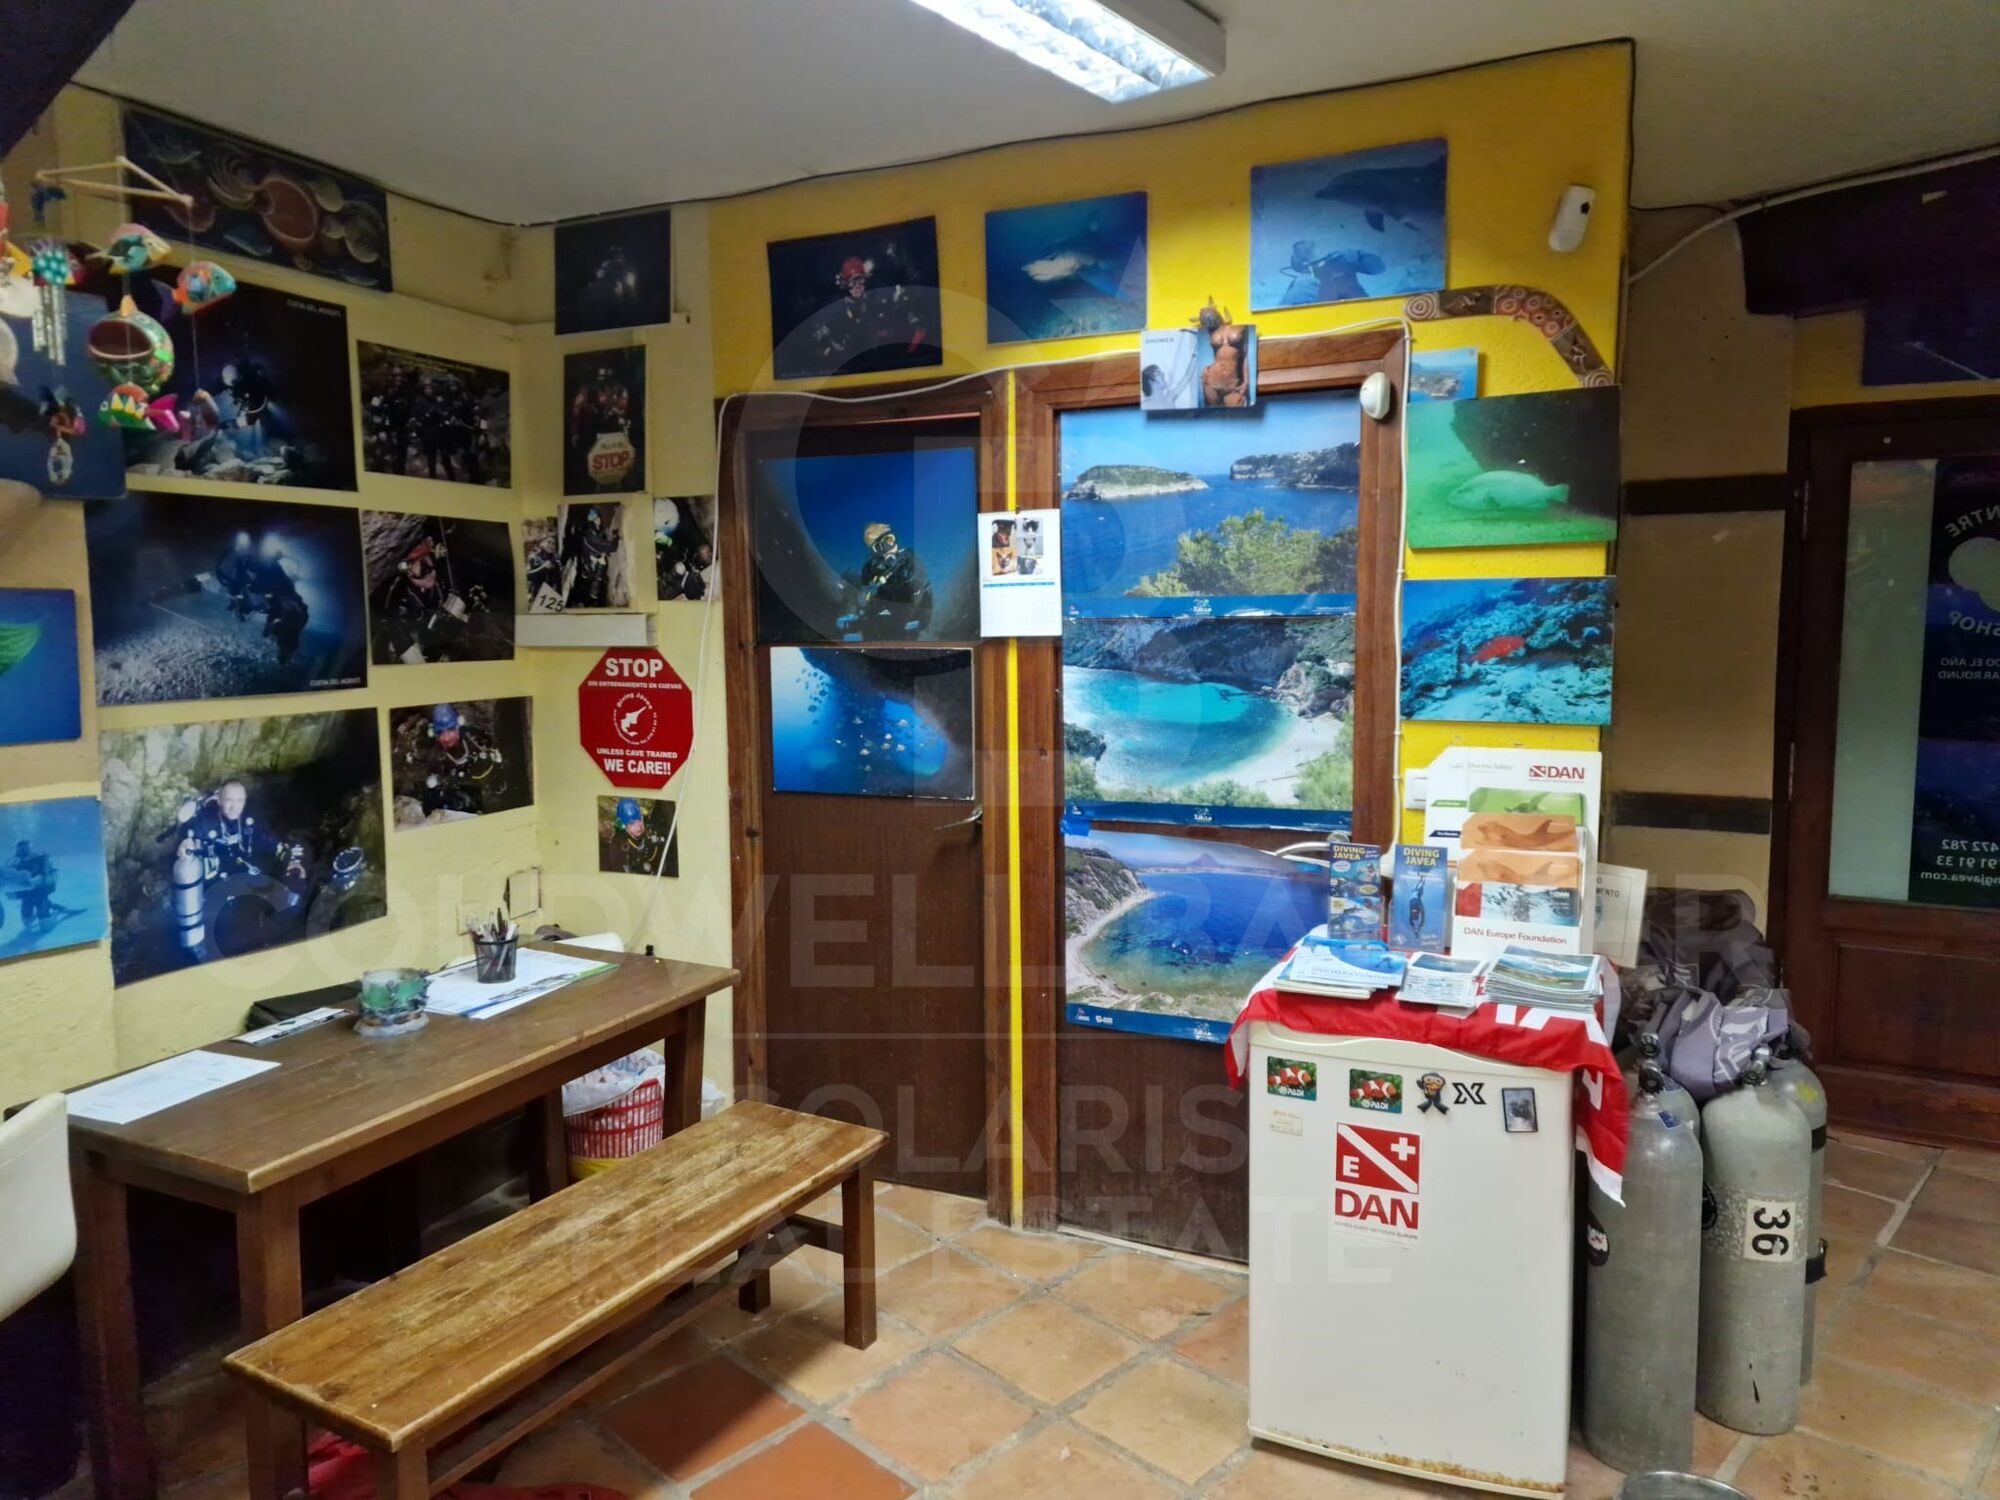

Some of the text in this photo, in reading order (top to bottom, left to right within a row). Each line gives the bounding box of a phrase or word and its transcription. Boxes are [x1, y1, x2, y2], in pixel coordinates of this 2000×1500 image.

[592, 451, 630, 470] STOP
[539, 594, 565, 613] 125
[605, 657, 664, 678] STOP
[596, 747, 678, 759] UNLESS CAVE TRAINED
[603, 758, 672, 776] WE CARE!!
[1547, 765, 1585, 780] DAN
[1333, 845, 1366, 854] DIVING
[1333, 852, 1361, 860] JAVEA
[1403, 847, 1440, 858] DIVING
[1405, 856, 1437, 866] JAVEA
[1463, 926, 1568, 945] DAN Europe Foundation
[1343, 1155, 1360, 1179] E
[1335, 1187, 1419, 1230] DAN
[1751, 1207, 1791, 1258] 36
